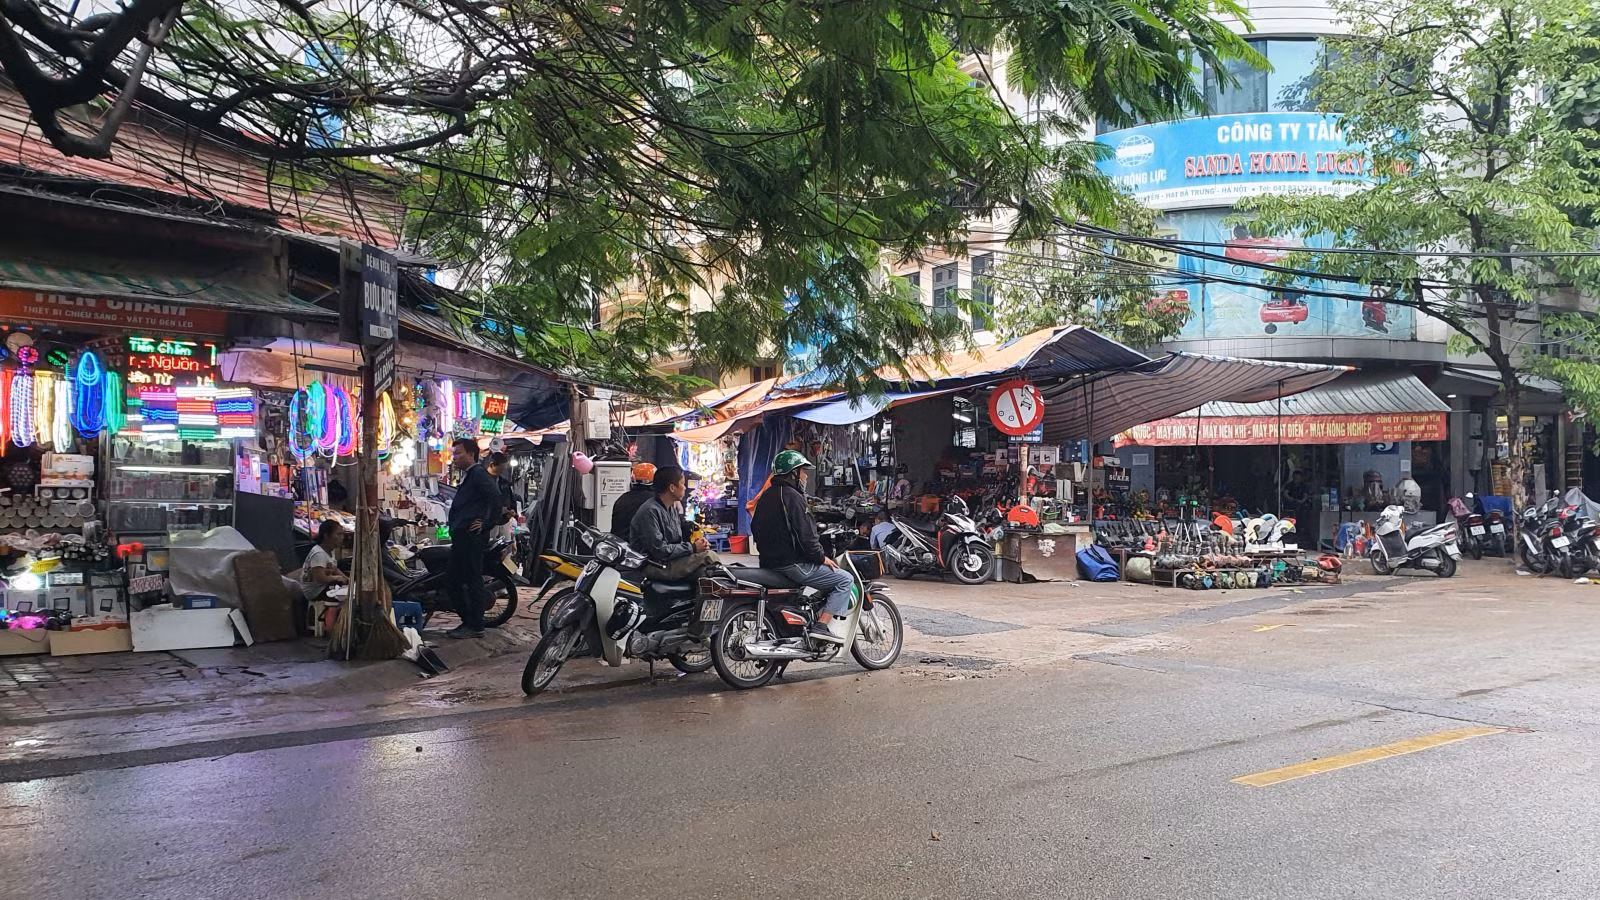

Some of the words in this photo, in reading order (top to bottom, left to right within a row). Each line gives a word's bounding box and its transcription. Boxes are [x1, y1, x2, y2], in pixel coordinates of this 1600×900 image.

[1217, 121, 1273, 144] CÔNG
[1278, 122, 1302, 142] TY
[1306, 119, 1343, 142] TÂN
[1184, 153, 1244, 179] SANDA
[1249, 151, 1310, 174] HONDA
[1315, 151, 1365, 176] LUCKY
